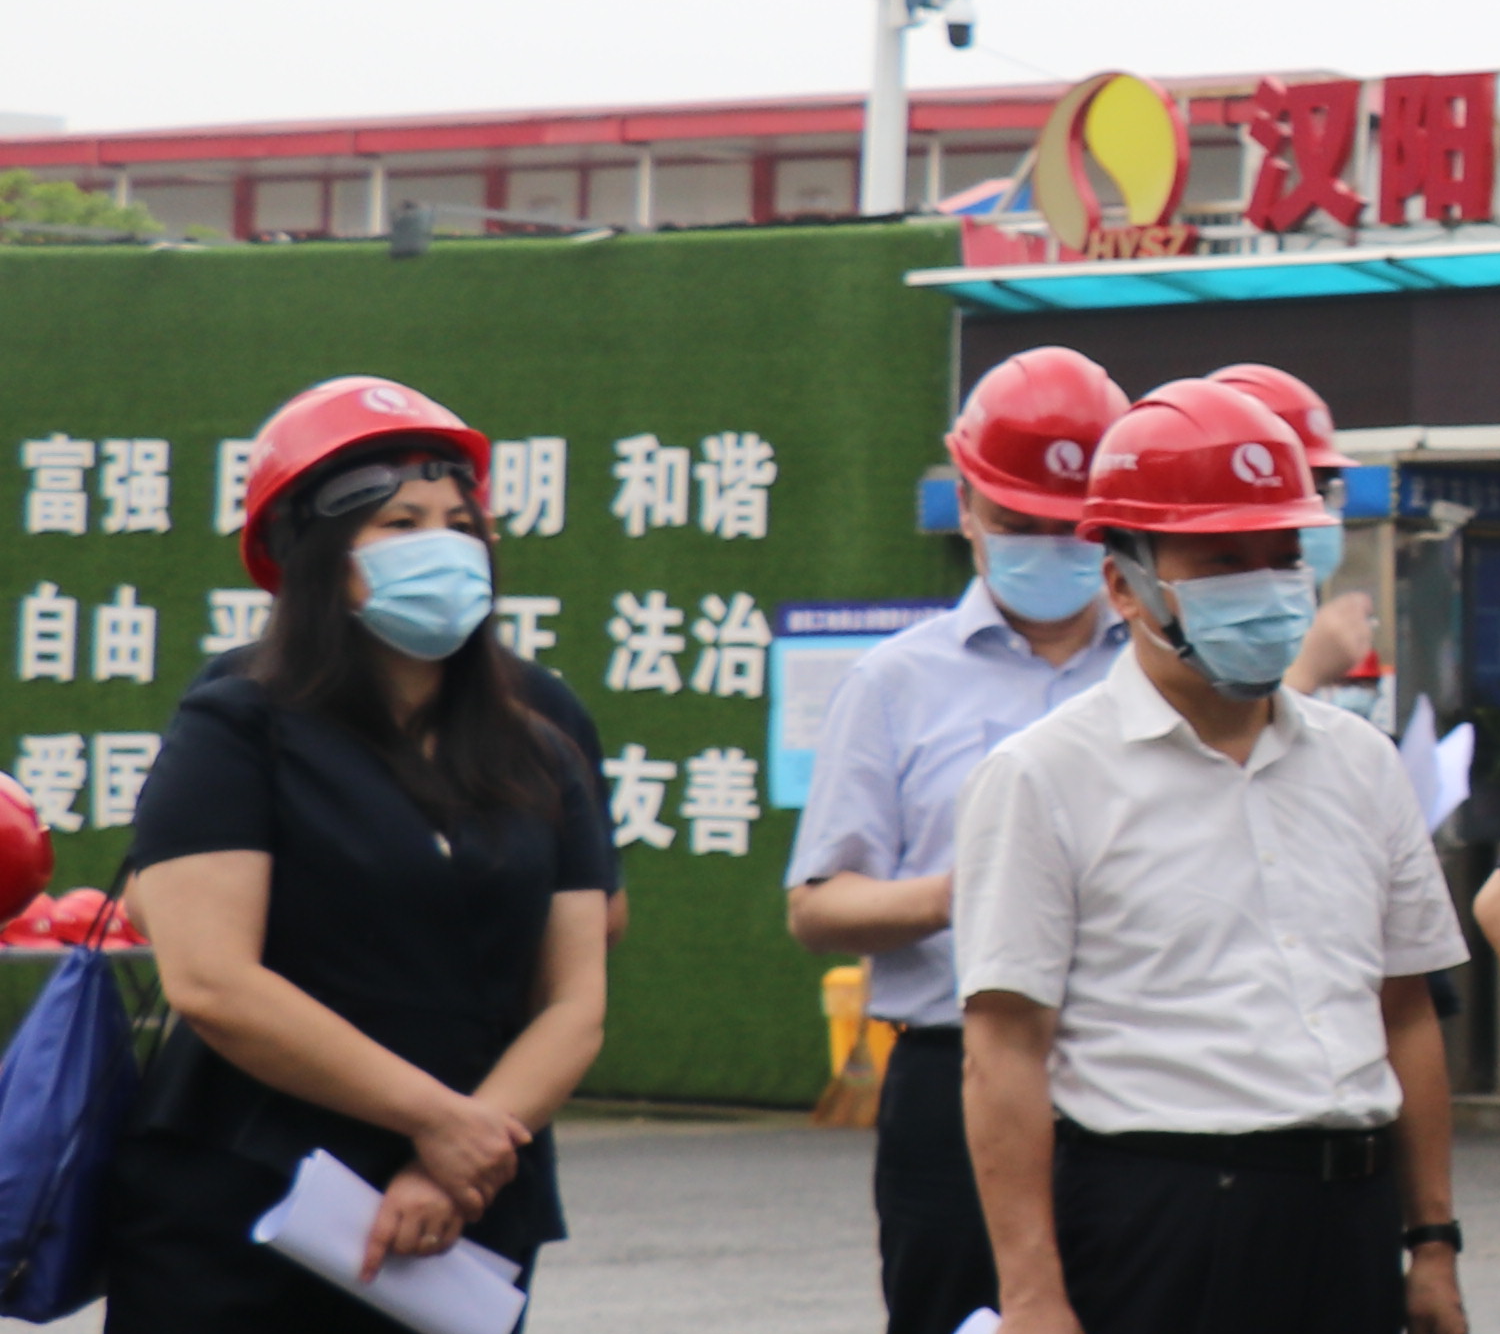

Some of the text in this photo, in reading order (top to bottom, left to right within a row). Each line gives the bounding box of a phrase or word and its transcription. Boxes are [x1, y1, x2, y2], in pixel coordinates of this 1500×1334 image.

[1087, 227, 1188, 261] HYSZ
[20, 432, 172, 536] 富强
[612, 432, 777, 539] 和谐
[17, 582, 157, 684] 自由
[606, 592, 772, 697] 法治
[13, 730, 762, 856] 爱国 友善
